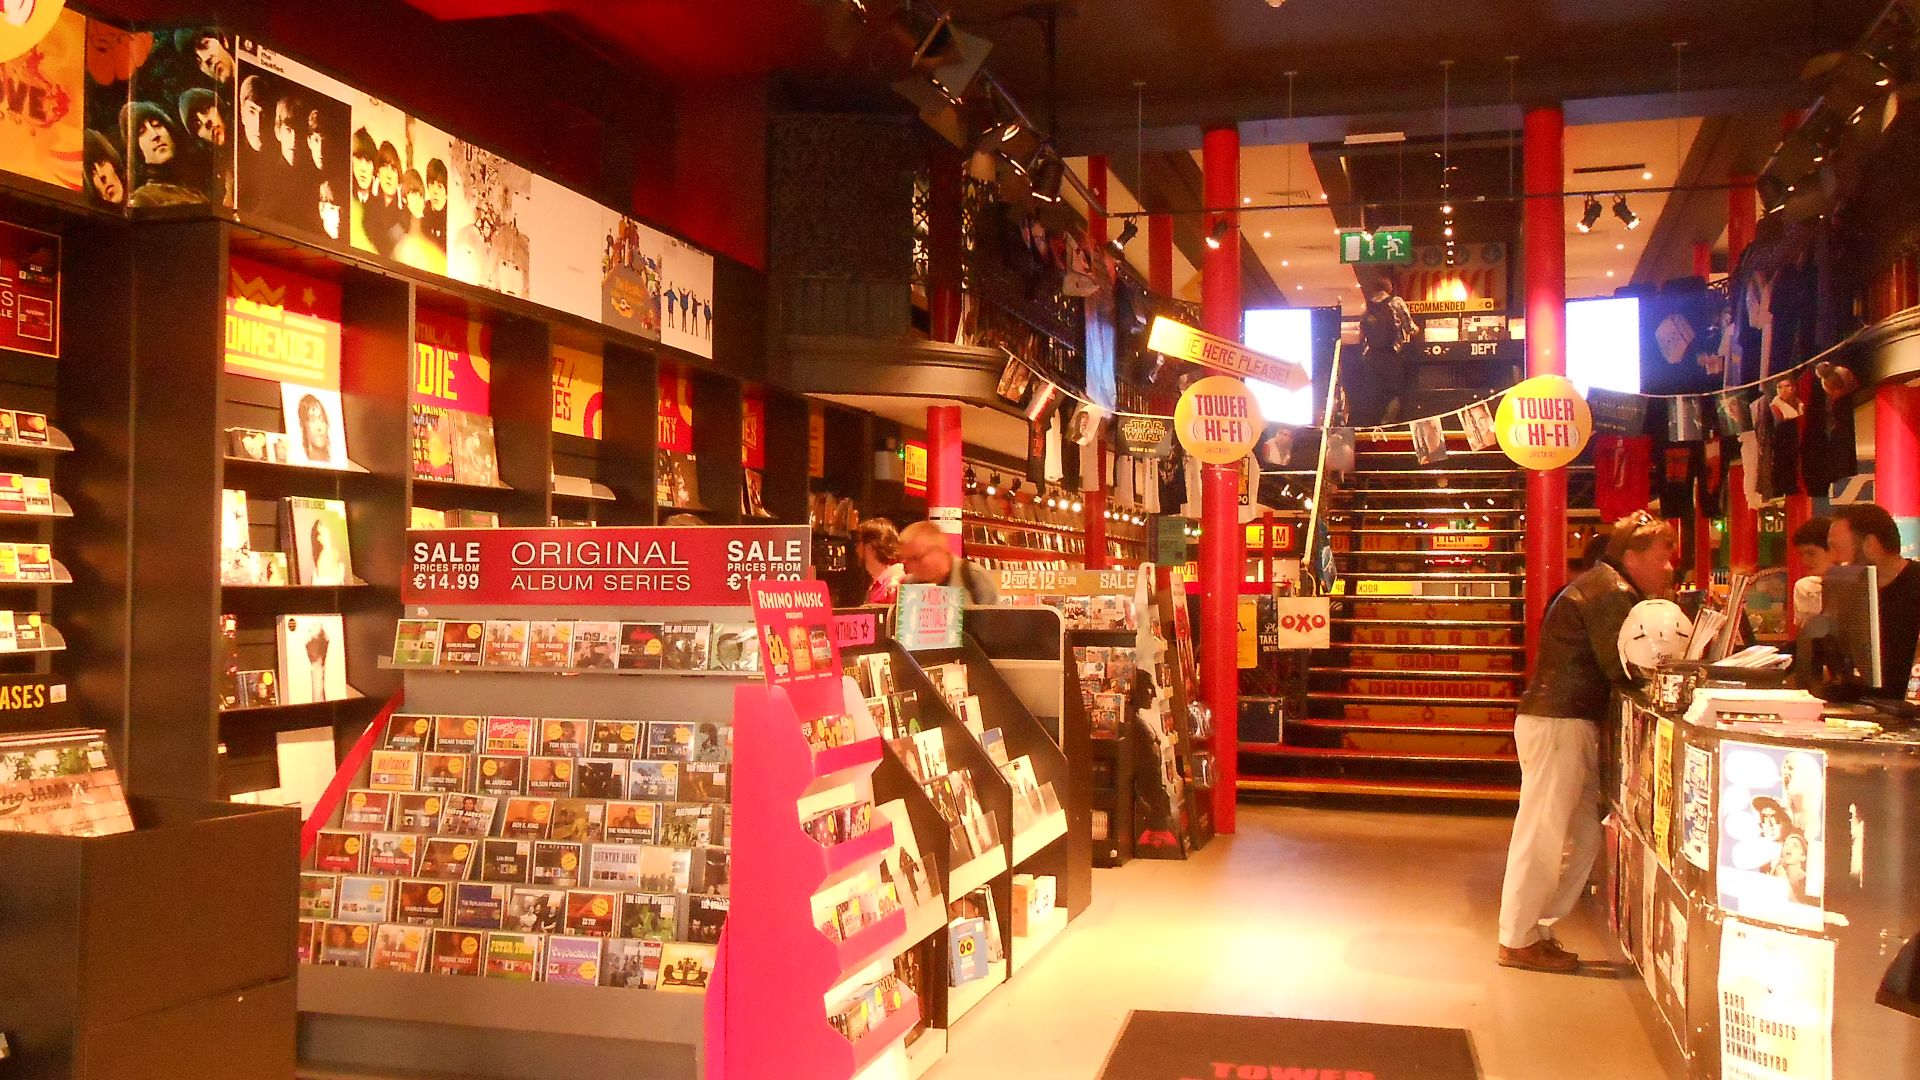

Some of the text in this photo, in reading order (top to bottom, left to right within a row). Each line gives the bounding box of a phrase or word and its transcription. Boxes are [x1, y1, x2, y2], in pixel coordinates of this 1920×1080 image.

[1471, 343, 1497, 355] DEPT
[1202, 342, 1235, 367] HERE
[1238, 354, 1291, 385] PLEASE!
[1195, 395, 1248, 419] TOWER
[1518, 397, 1575, 421] TOWER
[1125, 419, 1165, 431] STAR
[1205, 420, 1243, 443] HI-FI
[1125, 431, 1164, 443] WARS
[1528, 423, 1570, 447] HI-FI
[1259, 529, 1286, 542] FM
[413, 542, 480, 562] SALE
[511, 541, 689, 566] ORIGINAL
[727, 540, 802, 562] SALE
[413, 563, 479, 572] PRICES FROM
[727, 562, 801, 572] PRICES FROM
[413, 573, 479, 590] €14.99
[511, 574, 691, 592] ALBUM SERIES
[727, 573, 801, 591] €1499
[1001, 571, 1012, 590] 2
[1100, 573, 1136, 589] SALE
[758, 590, 824, 609] RHINO MUSIC
[1281, 614, 1326, 632] OXO
[1259, 635, 1277, 645] TAKE
[1725, 1007, 1797, 1041] ALMOST GHOSTS
